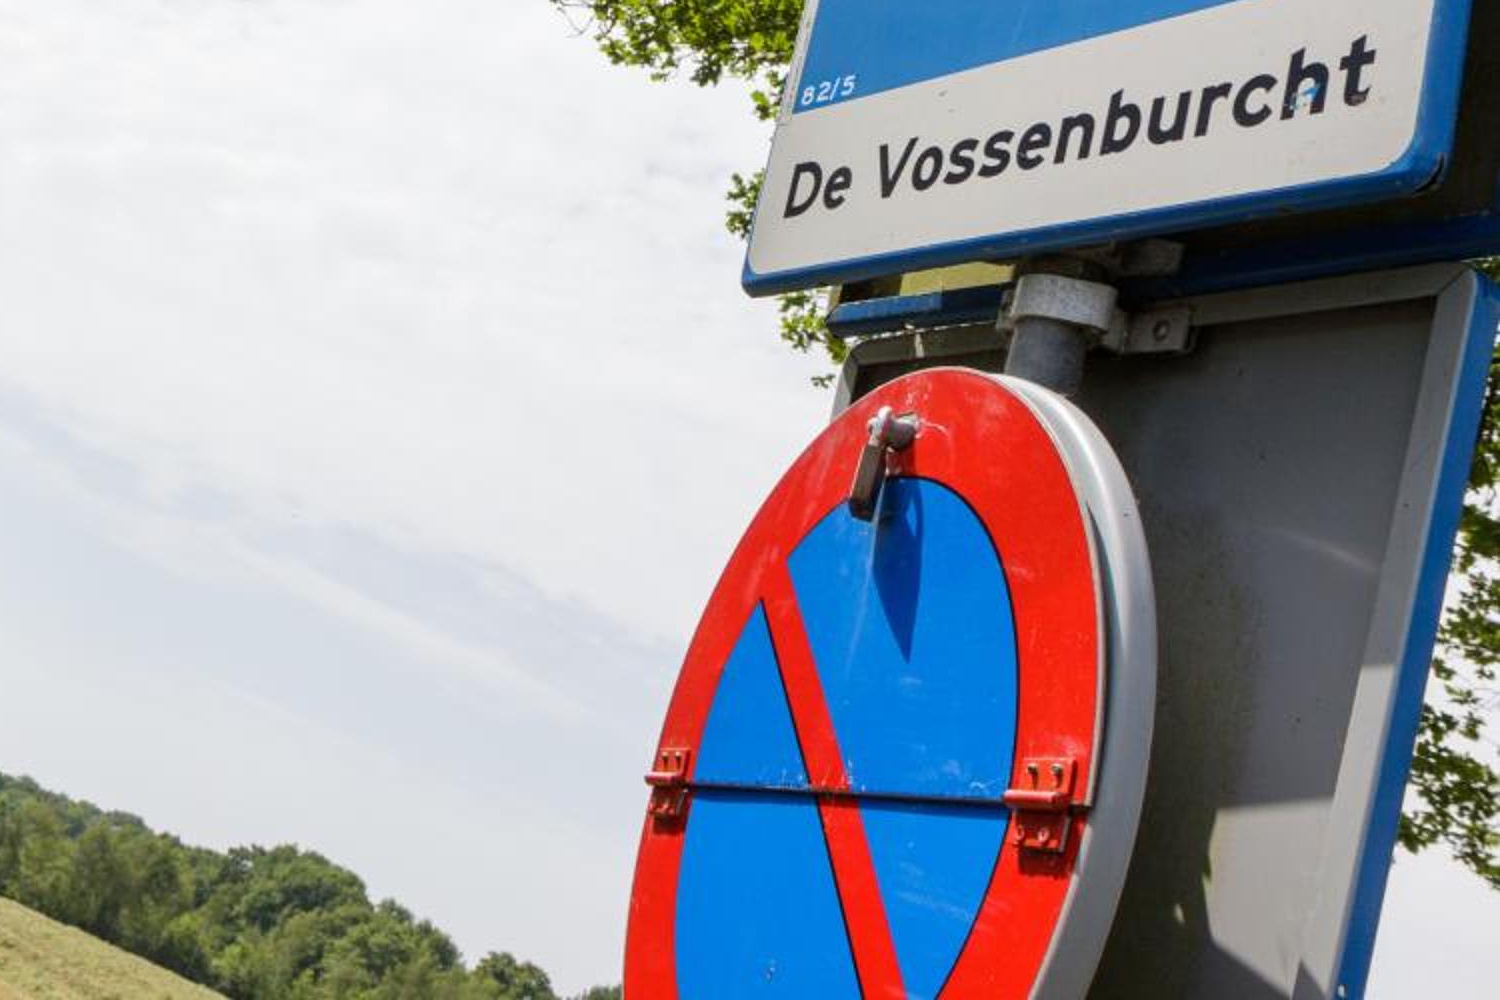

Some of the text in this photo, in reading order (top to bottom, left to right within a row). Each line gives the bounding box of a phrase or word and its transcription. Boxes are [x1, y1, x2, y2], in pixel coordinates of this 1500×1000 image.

[783, 34, 1376, 219] De Vossenburcht
[801, 75, 856, 105] 82/5
